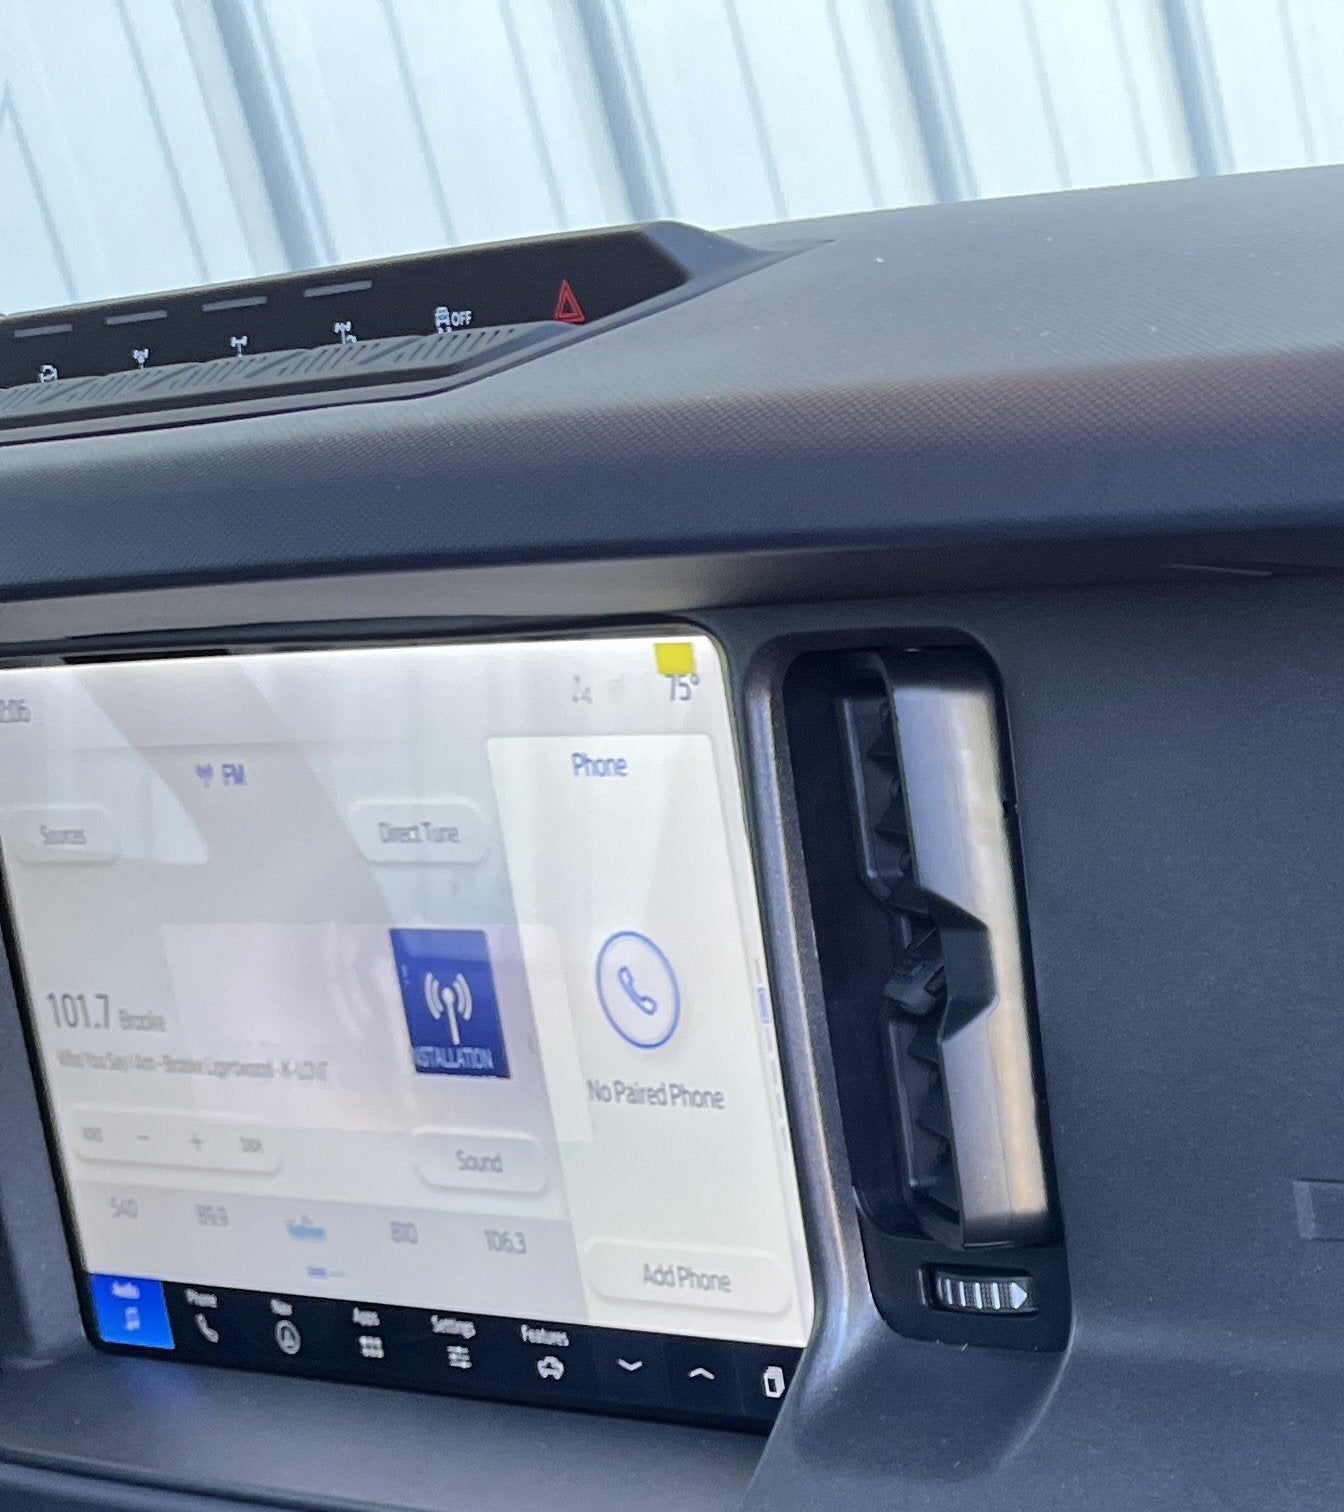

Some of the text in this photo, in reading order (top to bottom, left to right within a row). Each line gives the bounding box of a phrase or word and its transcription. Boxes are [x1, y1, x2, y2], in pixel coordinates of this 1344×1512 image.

[451, 310, 472, 326] OFF
[571, 752, 628, 777] Phone
[47, 992, 111, 1030] 101.7
[587, 1079, 725, 1109] No Paired Phone
[456, 1150, 503, 1173] Sound
[643, 1263, 732, 1293] Add Phone
